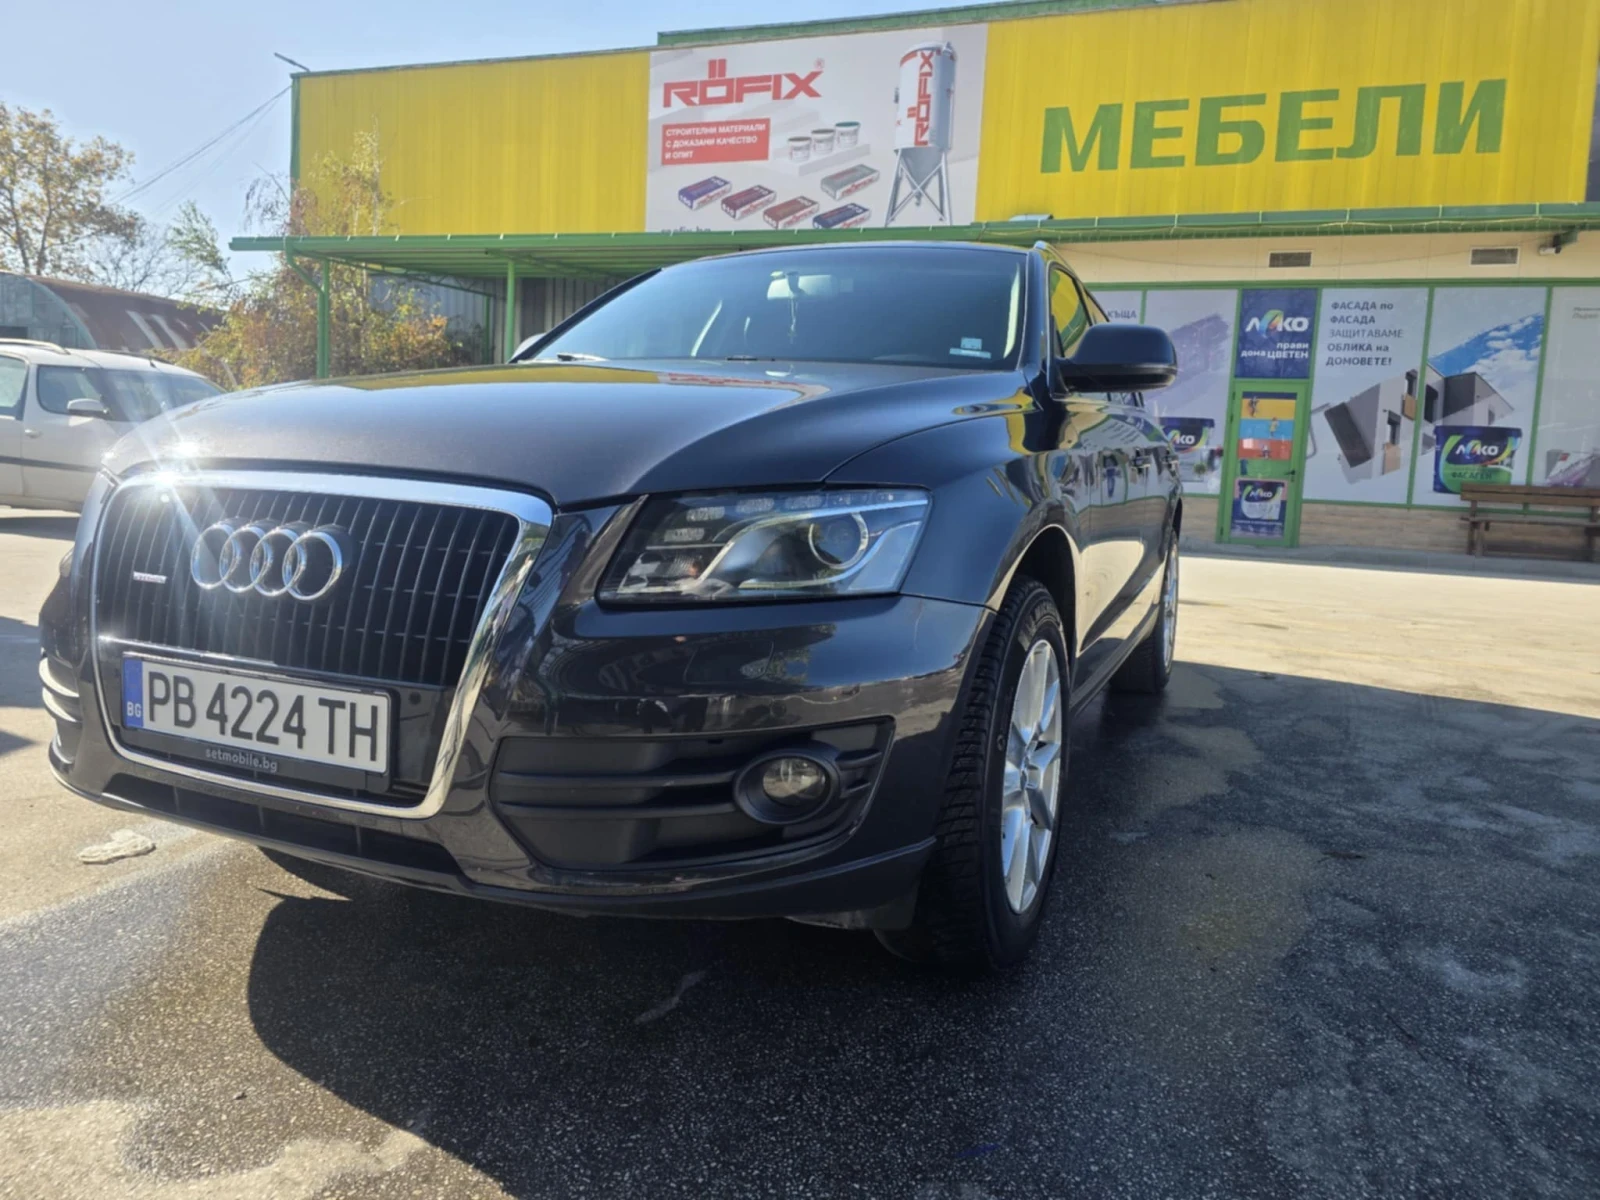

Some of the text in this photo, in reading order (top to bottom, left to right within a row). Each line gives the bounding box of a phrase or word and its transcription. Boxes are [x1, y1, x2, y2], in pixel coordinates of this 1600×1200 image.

[663, 58, 823, 108] RÖFIX
[907, 51, 933, 147] RÖFIX
[665, 123, 766, 137] СТРОИТЕЛНИ МАТЕРИАЛИ
[1040, 79, 1507, 174] МЕБЕЛИ
[716, 136, 758, 145] КАЧЕСТВО
[672, 150, 694, 159] ОПИТ
[1331, 301, 1377, 311] ФАСАДА
[1330, 315, 1376, 325] ФАСАДА
[1329, 328, 1404, 338] ЗАЩИТАВАМЕ
[1276, 342, 1309, 350] прави
[1327, 343, 1389, 352] ОБЛИКА на
[1241, 350, 1309, 360] дома ЦВЕТЕН
[1325, 356, 1392, 366] ДОМОВЕТЕ!
[126, 701, 142, 718] BG
[148, 671, 378, 762] PB 4224 TH
[205, 748, 278, 774] setmobile.bg
